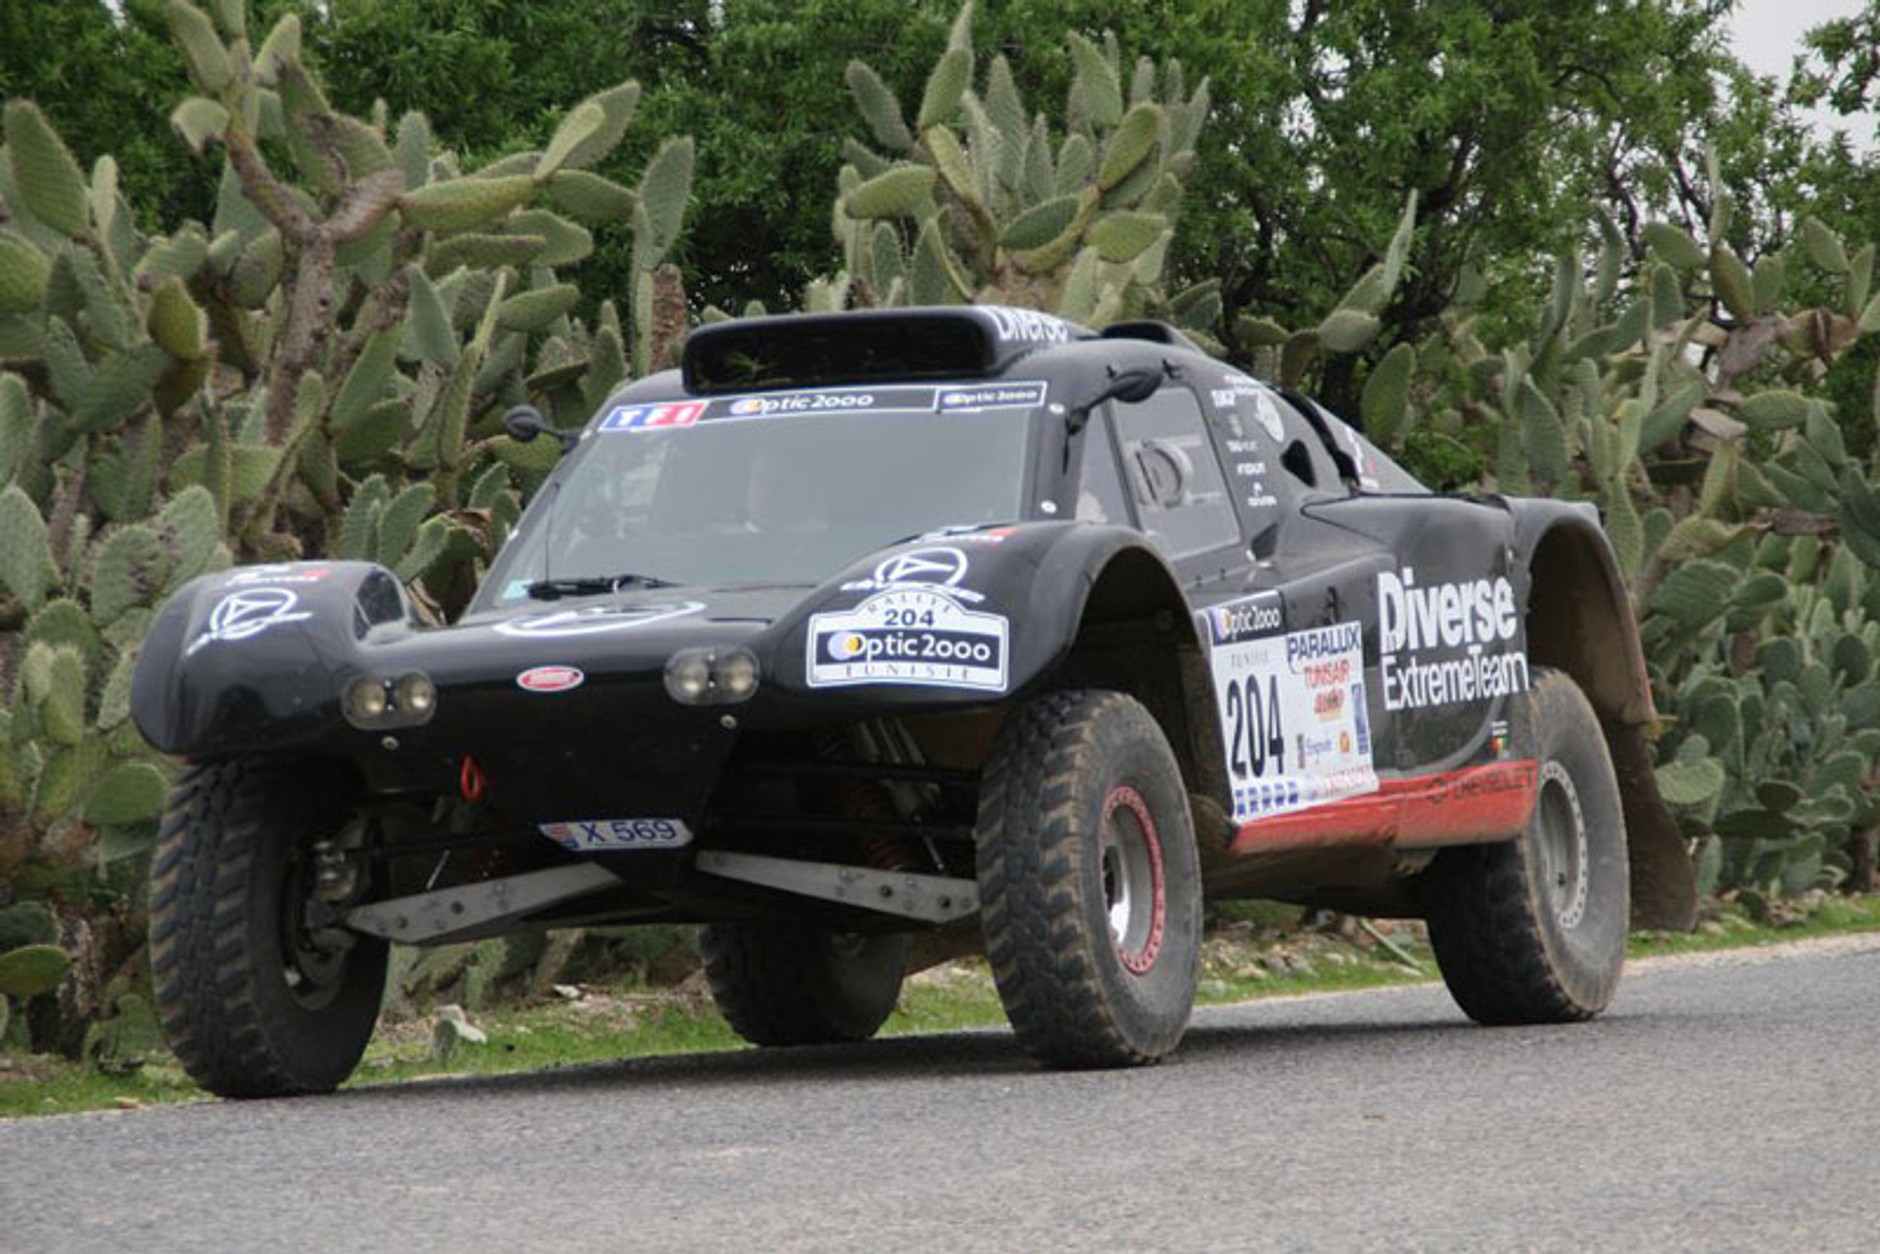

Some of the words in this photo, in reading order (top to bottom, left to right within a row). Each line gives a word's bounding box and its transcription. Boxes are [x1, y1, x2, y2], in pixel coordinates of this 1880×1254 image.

[617, 406, 695, 427] TF1
[884, 608, 935, 627] 204
[1378, 566, 1517, 654] Diverse
[1287, 625, 1361, 664] PARALUX
[1227, 673, 1285, 780] 204
[580, 822, 606, 842] X
[611, 819, 677, 841] 569
